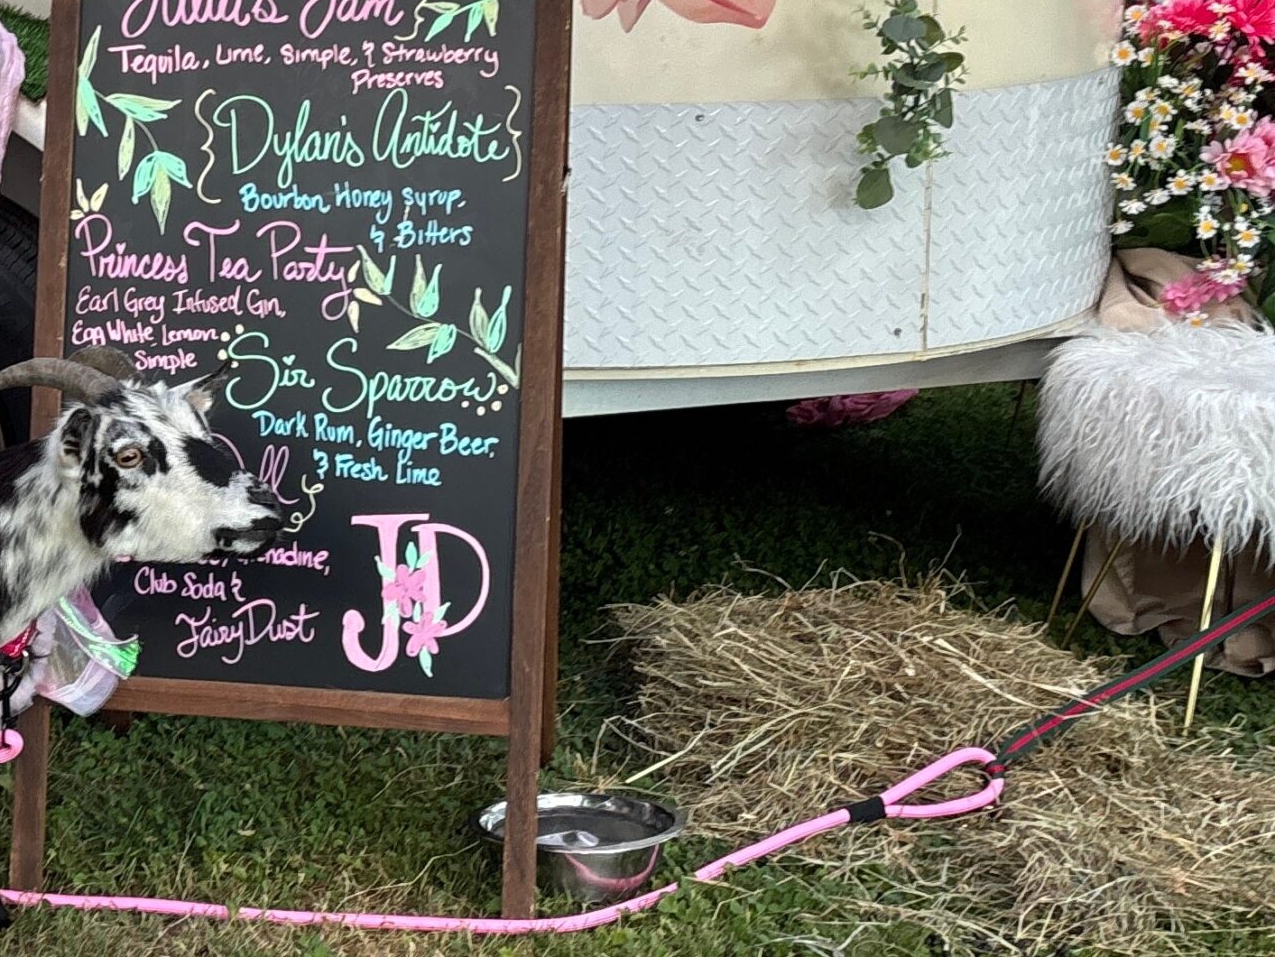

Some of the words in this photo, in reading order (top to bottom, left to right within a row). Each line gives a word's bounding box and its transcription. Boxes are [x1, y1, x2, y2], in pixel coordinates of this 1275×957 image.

[108, 44, 209, 84] Tequila,
[382, 43, 499, 78] Strawberry
[213, 94, 365, 189] Dylan's
[372, 88, 509, 169] Antidote
[334, 181, 393, 224] Honey
[397, 220, 474, 248] Bitters
[75, 214, 189, 283] Princess
[183, 220, 262, 283] Tea
[256, 220, 355, 320] Party
[75, 286, 119, 315] Earl
[124, 287, 166, 324] Grey
[172, 285, 244, 315] Infused
[71, 320, 106, 345] Egg
[134, 348, 198, 375] Simple
[225, 331, 316, 410] Sir
[322, 337, 497, 419] Sparrow
[251, 410, 310, 438] Dark
[367, 416, 438, 455] Ginger
[334, 453, 390, 483] Fresh
[394, 452, 444, 487] Lime
[133, 565, 178, 595] Club
[181, 571, 227, 602] Soda
[174, 606, 246, 665] Fairy
[231, 598, 322, 646] Dust
